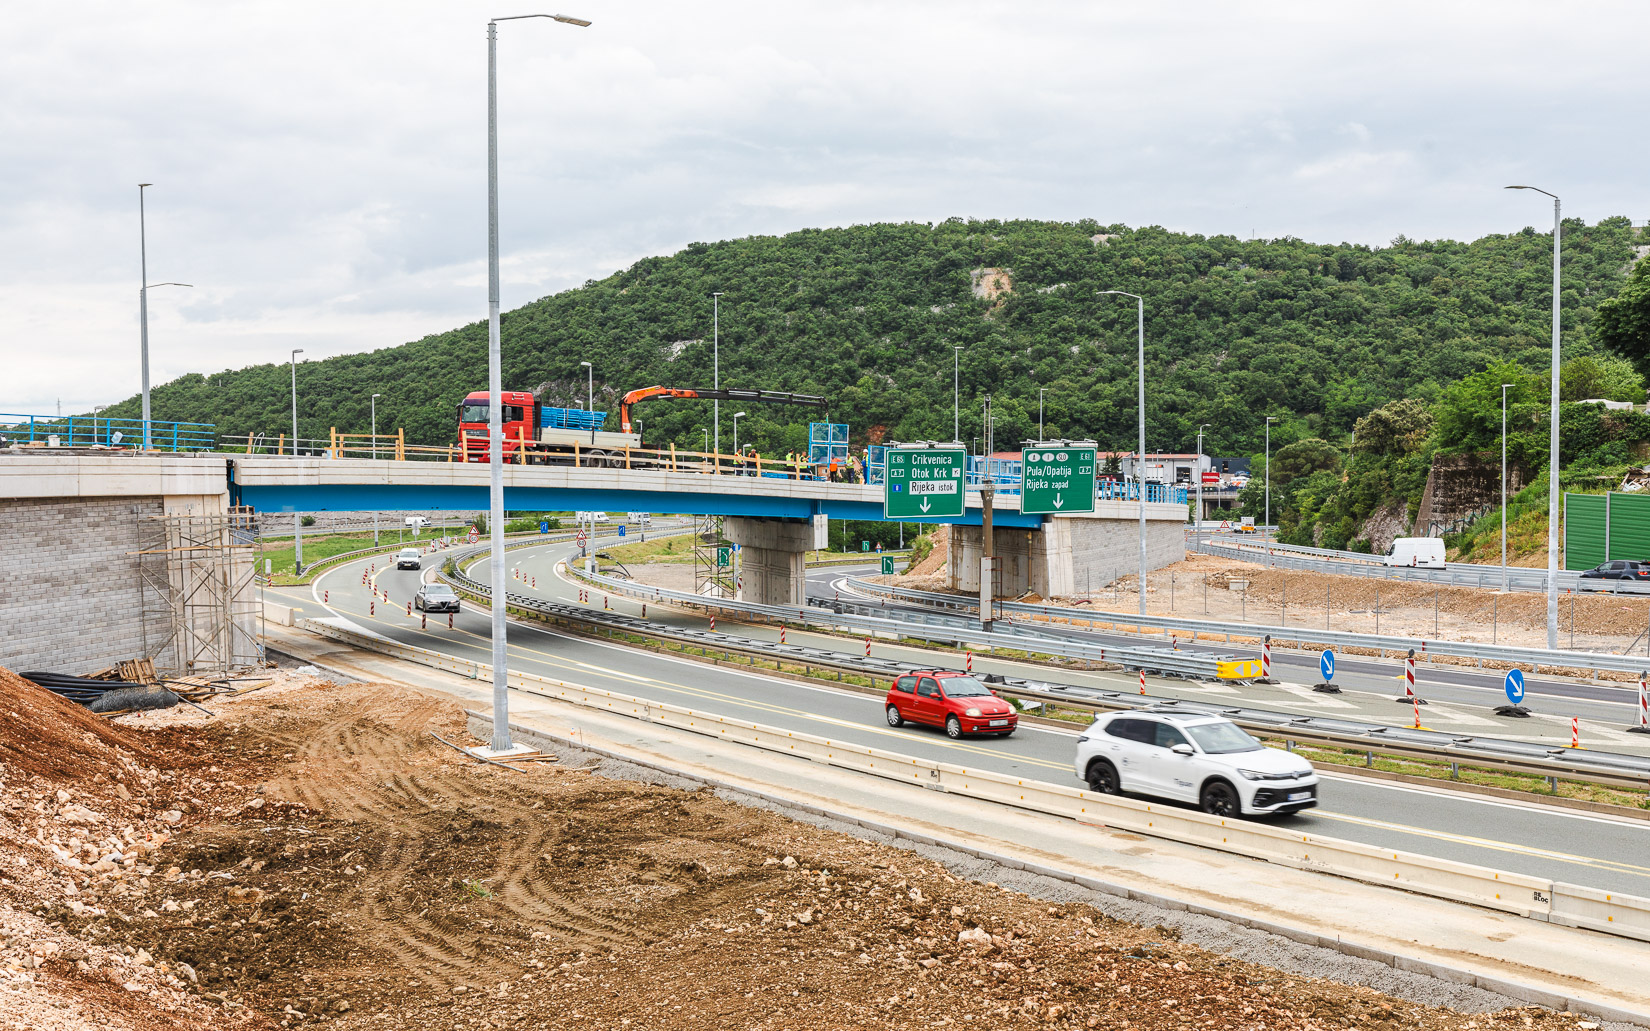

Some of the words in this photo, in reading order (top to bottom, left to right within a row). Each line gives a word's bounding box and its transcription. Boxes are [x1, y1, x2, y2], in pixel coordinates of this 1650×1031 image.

[912, 454, 952, 465] Crikvenica
[911, 468, 930, 478] Otok
[934, 467, 947, 478] Krk
[1026, 465, 1072, 478] Pula/Opatija
[911, 481, 935, 494] Rijeka
[938, 482, 954, 491] istok
[1026, 479, 1049, 491] Rijeka
[1051, 480, 1069, 490] zapad
